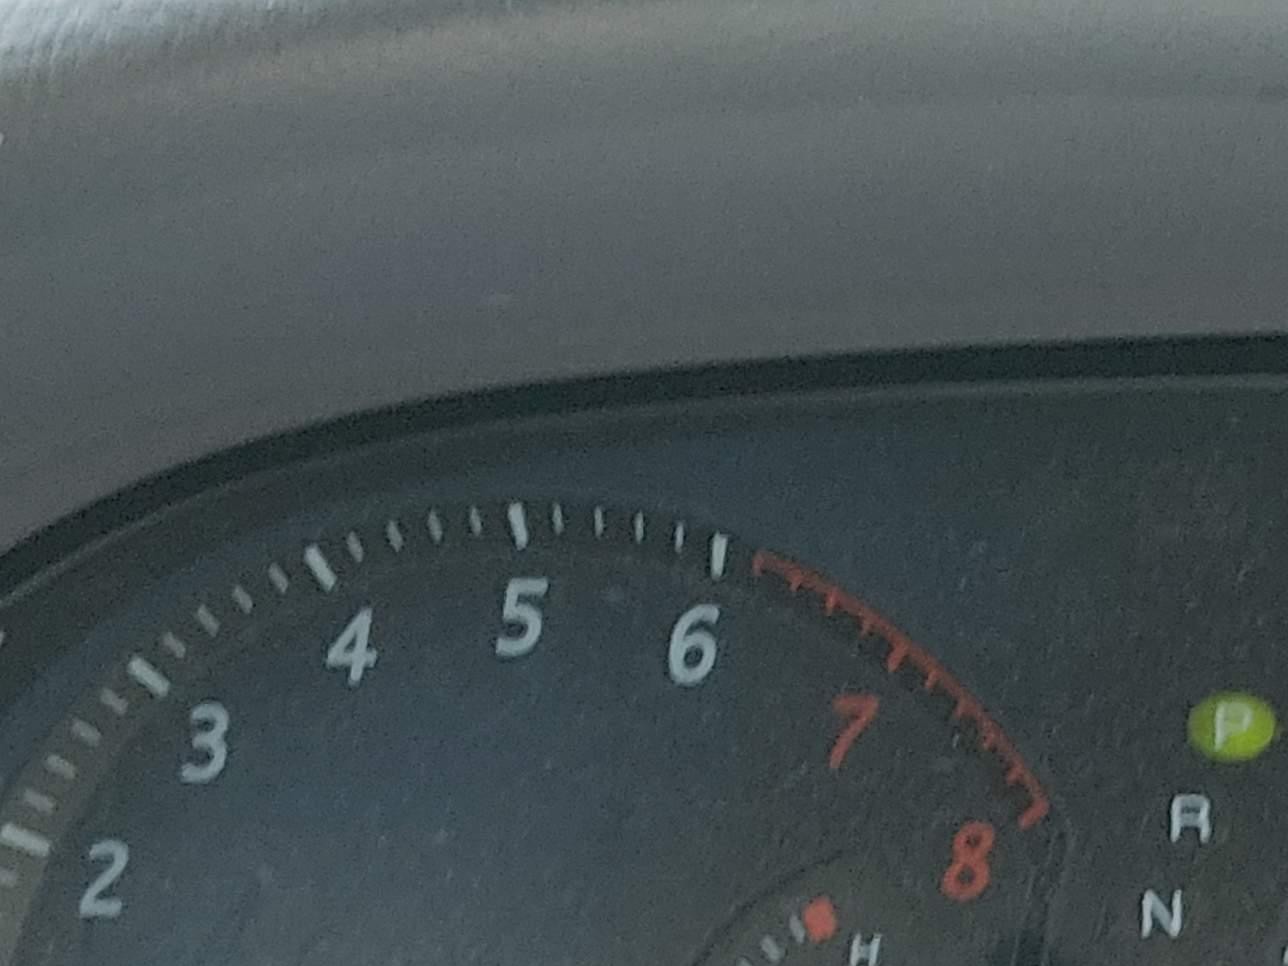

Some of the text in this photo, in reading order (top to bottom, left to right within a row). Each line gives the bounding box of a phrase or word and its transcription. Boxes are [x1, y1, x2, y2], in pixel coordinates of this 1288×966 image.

[326, 607, 378, 687] 4
[496, 577, 549, 658] 5
[668, 604, 719, 687] 6
[180, 702, 230, 783] 3
[830, 696, 879, 769] 7
[1214, 701, 1252, 752] P
[1170, 794, 1211, 843] R
[79, 840, 129, 918] 2
[942, 821, 995, 900] 8
[1141, 889, 1183, 937] N
